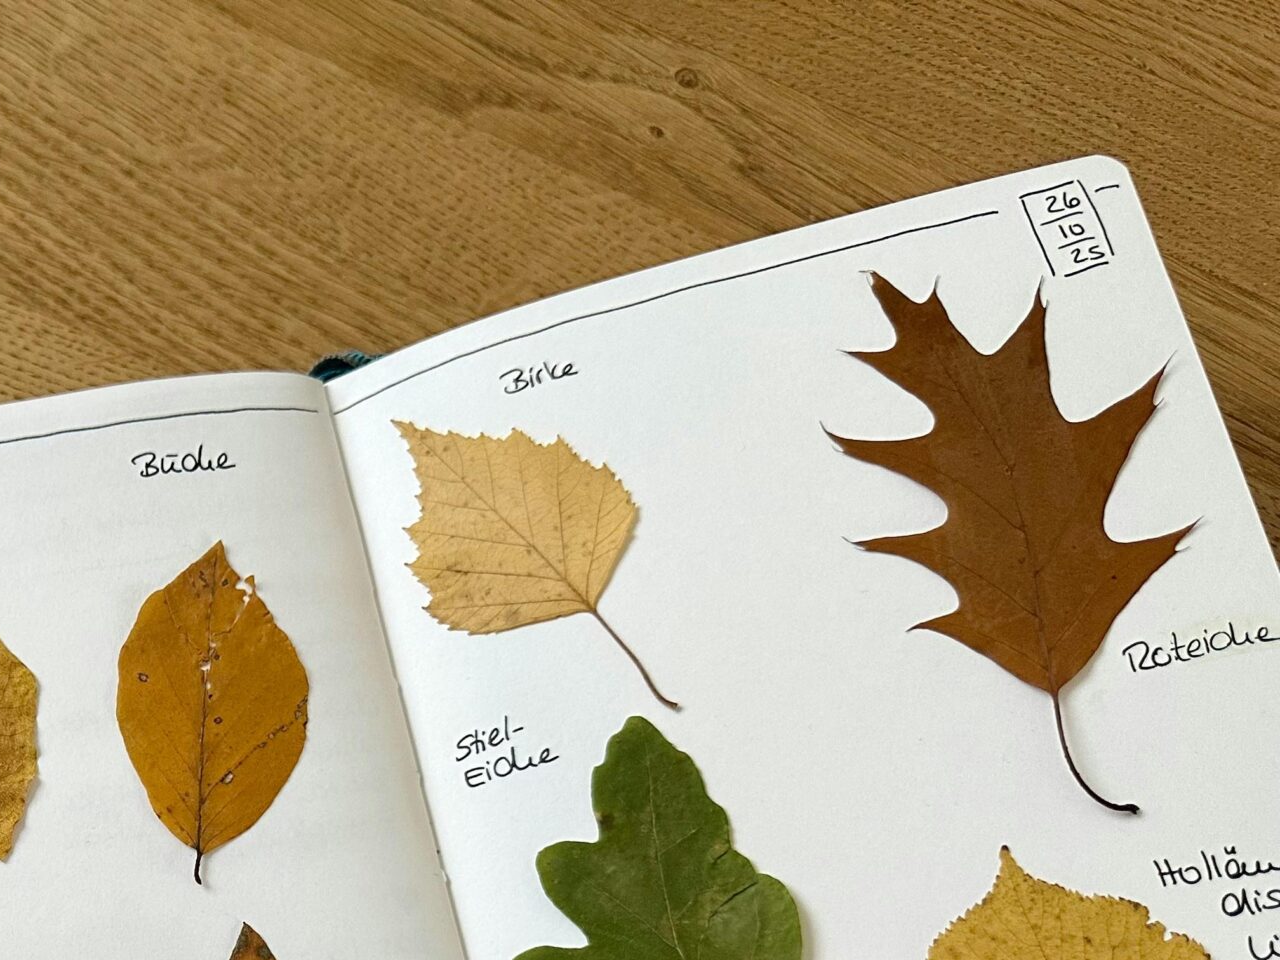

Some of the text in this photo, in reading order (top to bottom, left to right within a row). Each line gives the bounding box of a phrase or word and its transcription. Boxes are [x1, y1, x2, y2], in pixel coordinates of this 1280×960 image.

[1045, 191, 1081, 214] 26
[1058, 223, 1086, 239] 10
[1071, 245, 1106, 264] 25
[498, 361, 579, 395] Birke
[1121, 621, 1280, 673] Roteiche
[464, 745, 560, 789] Eiche
